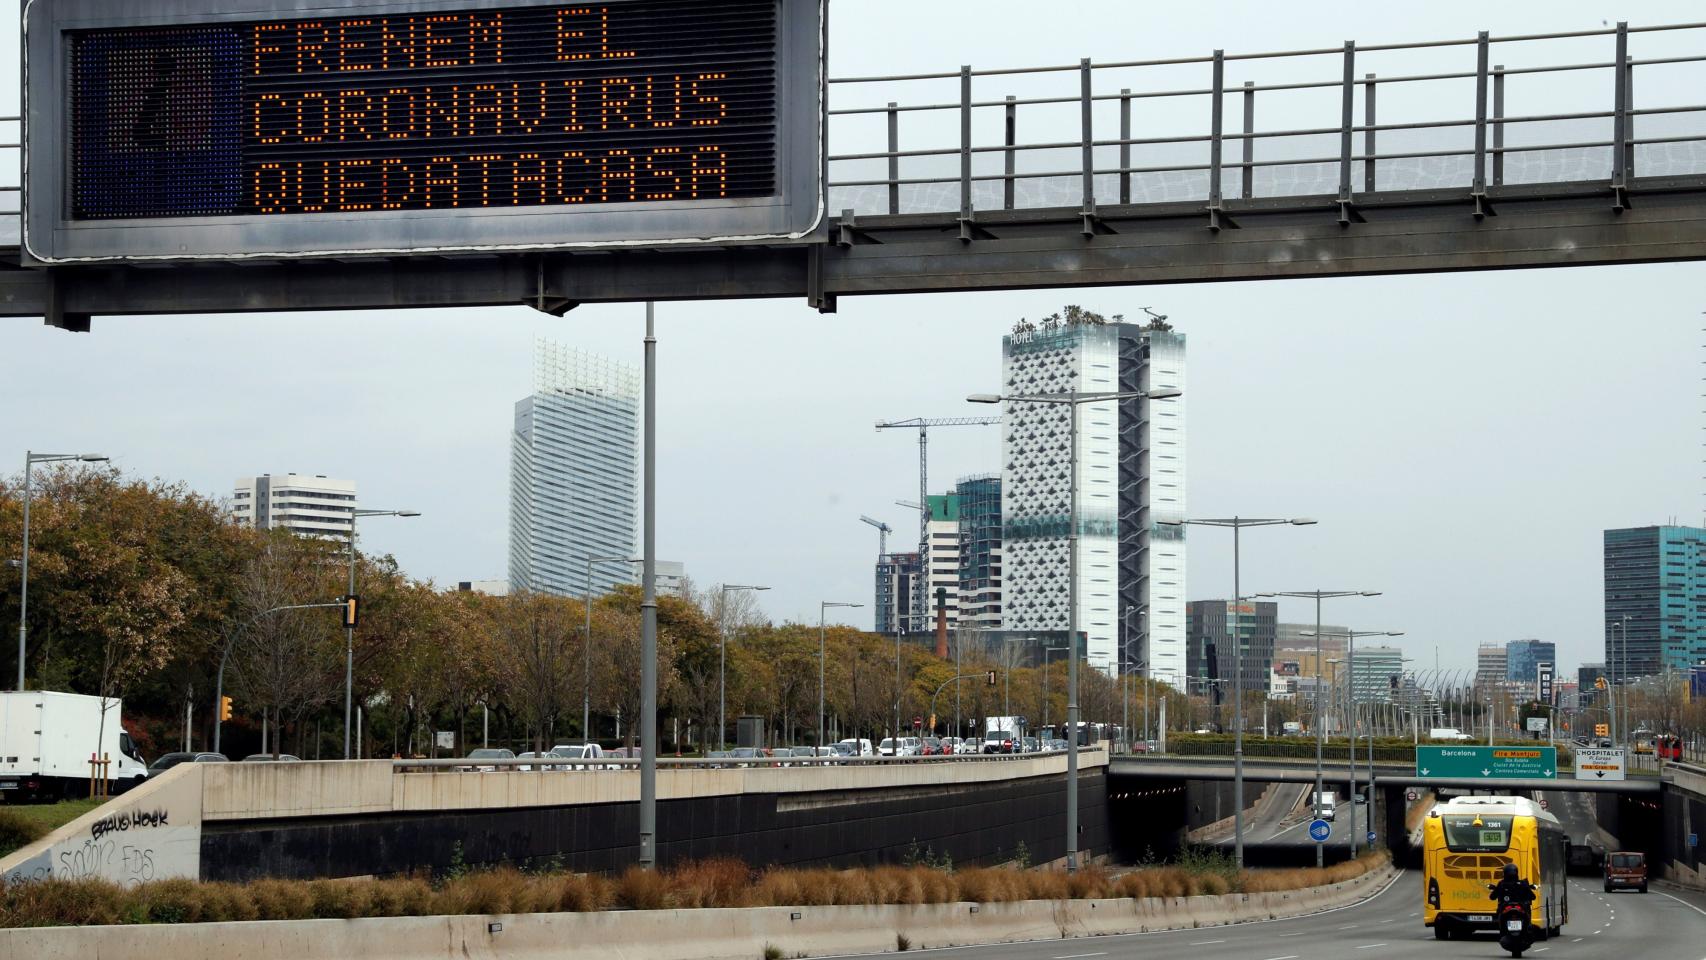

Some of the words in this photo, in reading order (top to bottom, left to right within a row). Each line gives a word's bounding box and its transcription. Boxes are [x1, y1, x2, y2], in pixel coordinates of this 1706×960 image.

[253, 13, 504, 74] FRENEM
[556, 8, 637, 61] EL
[254, 73, 727, 145] CORONAVIRUS
[254, 146, 727, 213] QUEDATACASA
[1010, 331, 1034, 345] HOTEL
[1441, 749, 1476, 757] Barcelona
